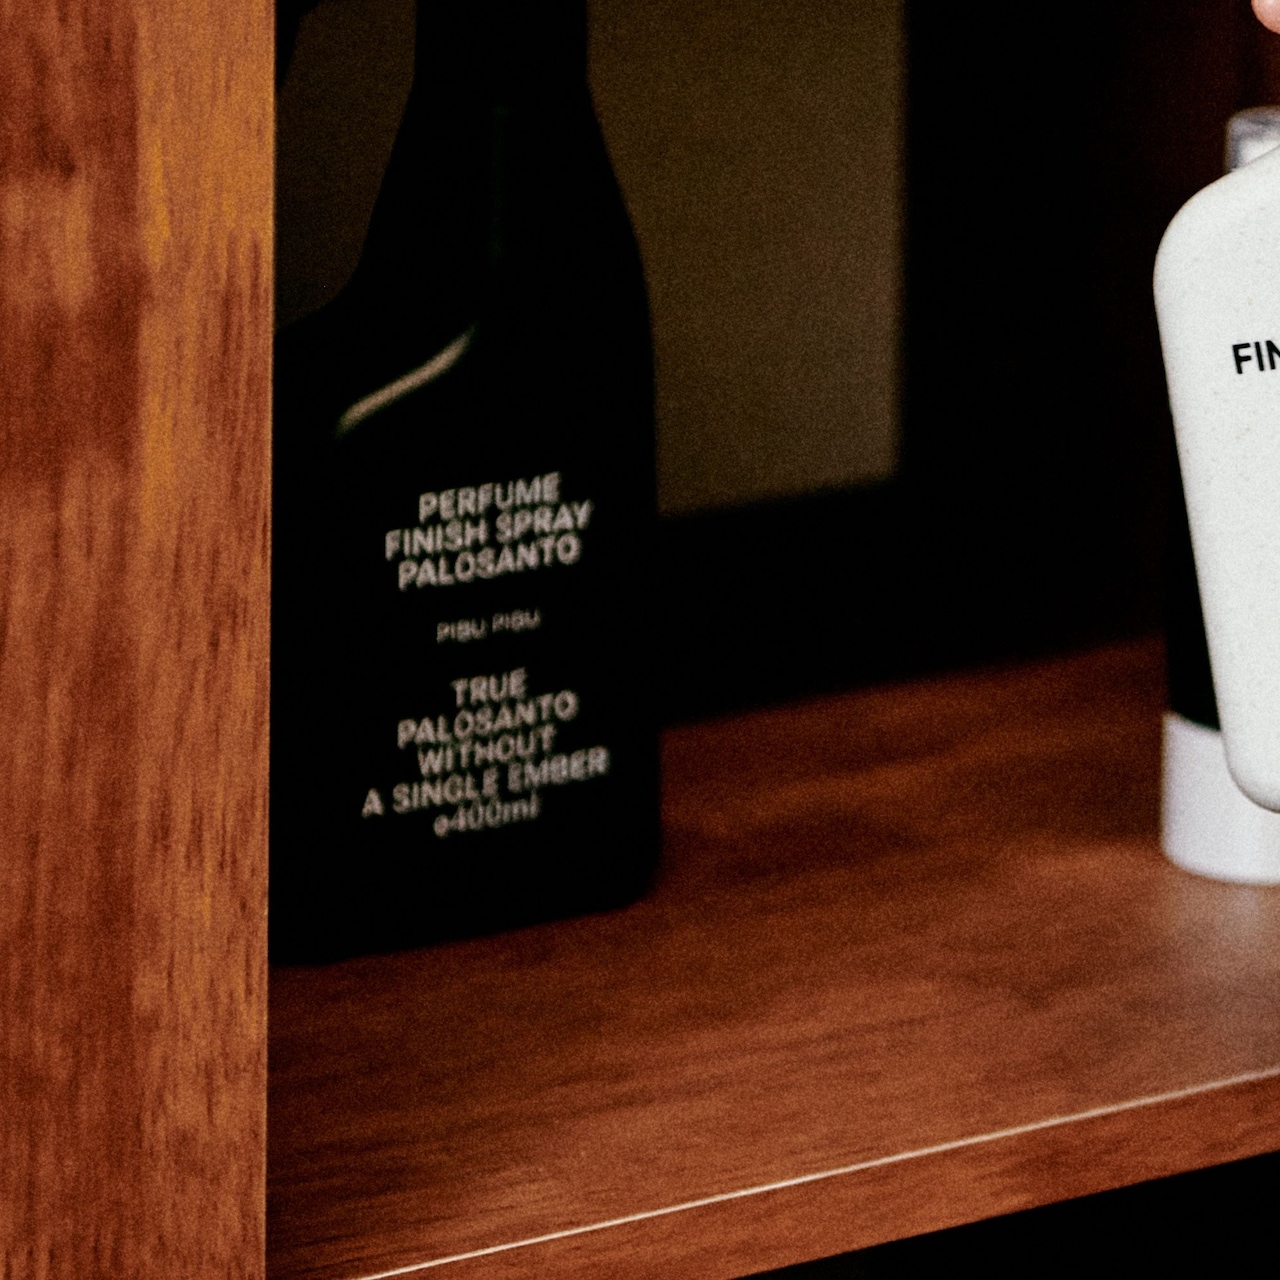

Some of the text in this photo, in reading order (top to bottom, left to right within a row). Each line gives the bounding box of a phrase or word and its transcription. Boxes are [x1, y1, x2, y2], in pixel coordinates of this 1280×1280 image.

[419, 471, 561, 521] PERFUME
[385, 499, 594, 561] FINISH SPRAY
[398, 533, 582, 591] PALOSANTO
[451, 667, 528, 707] TRUE
[398, 690, 579, 749] PALOSANTO
[418, 724, 556, 777] WITHOUT
[361, 746, 610, 818] A SINGLE EMBER
